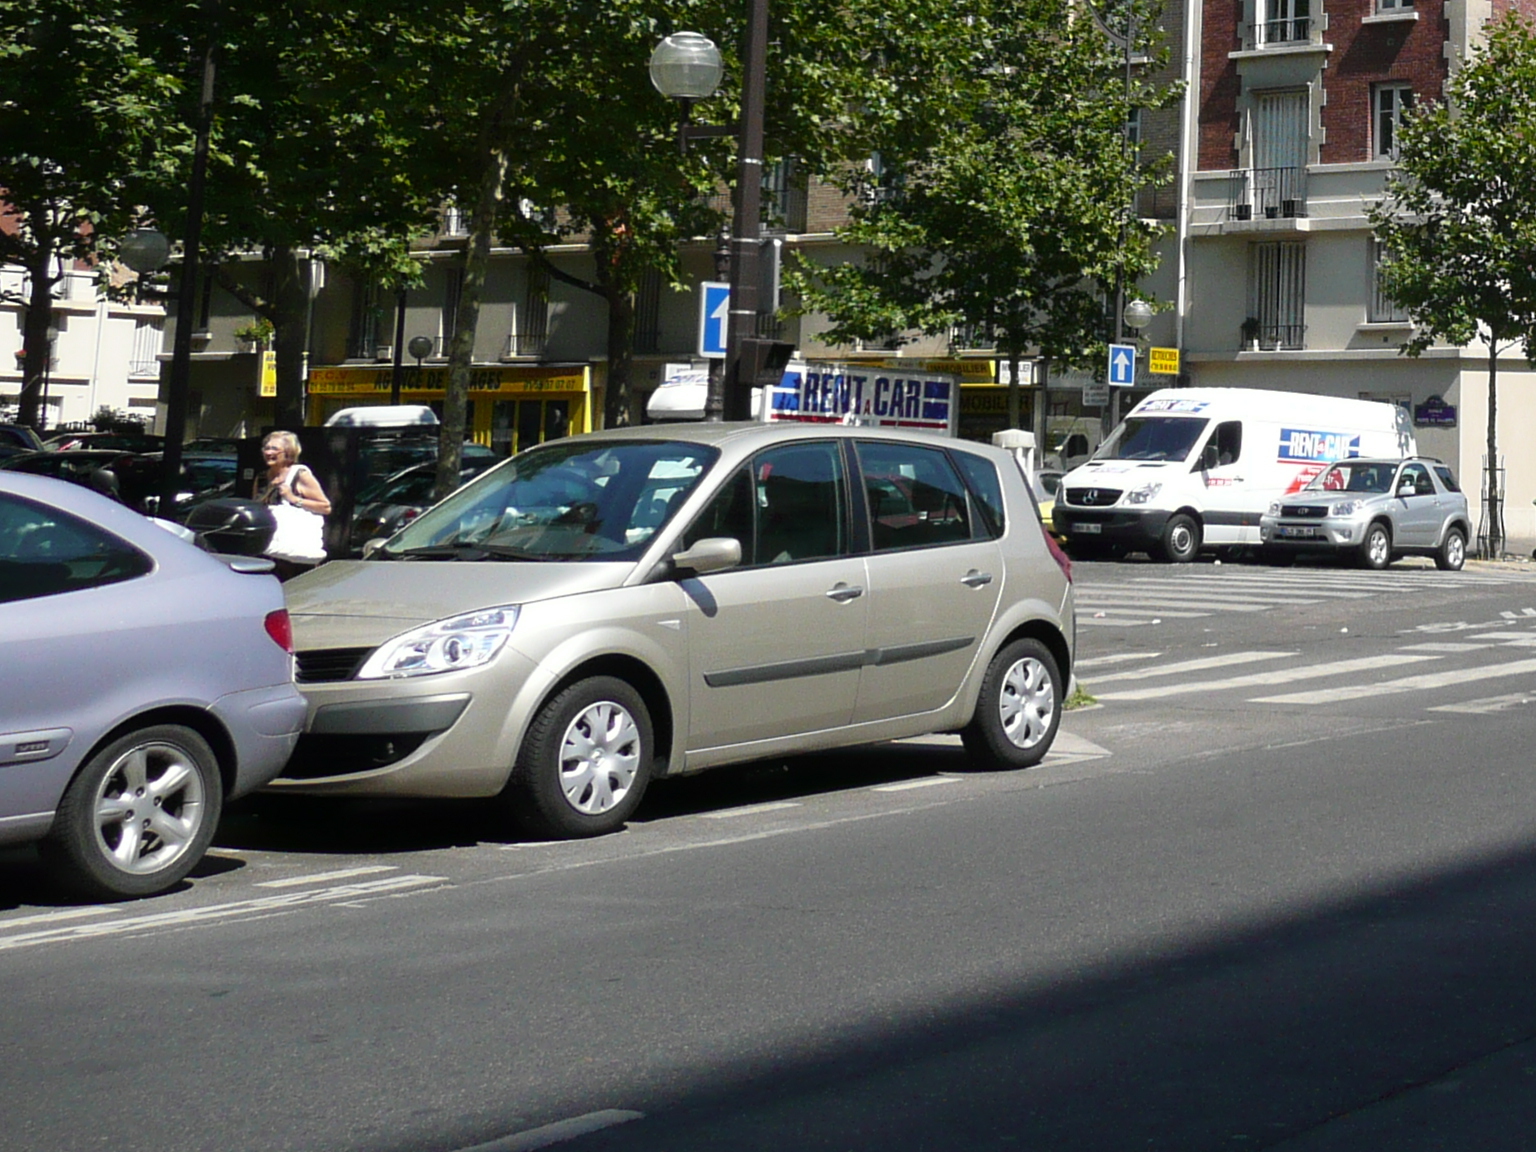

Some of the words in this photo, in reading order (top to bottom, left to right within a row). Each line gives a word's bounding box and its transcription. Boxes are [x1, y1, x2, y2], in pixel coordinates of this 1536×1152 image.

[374, 370, 422, 390] AGNCE
[427, 370, 445, 390] DE
[803, 372, 868, 415] RENT
[864, 399, 871, 416] A
[873, 377, 922, 419] CAR
[1289, 431, 1322, 458] RENT
[1324, 434, 1350, 459] CAR
